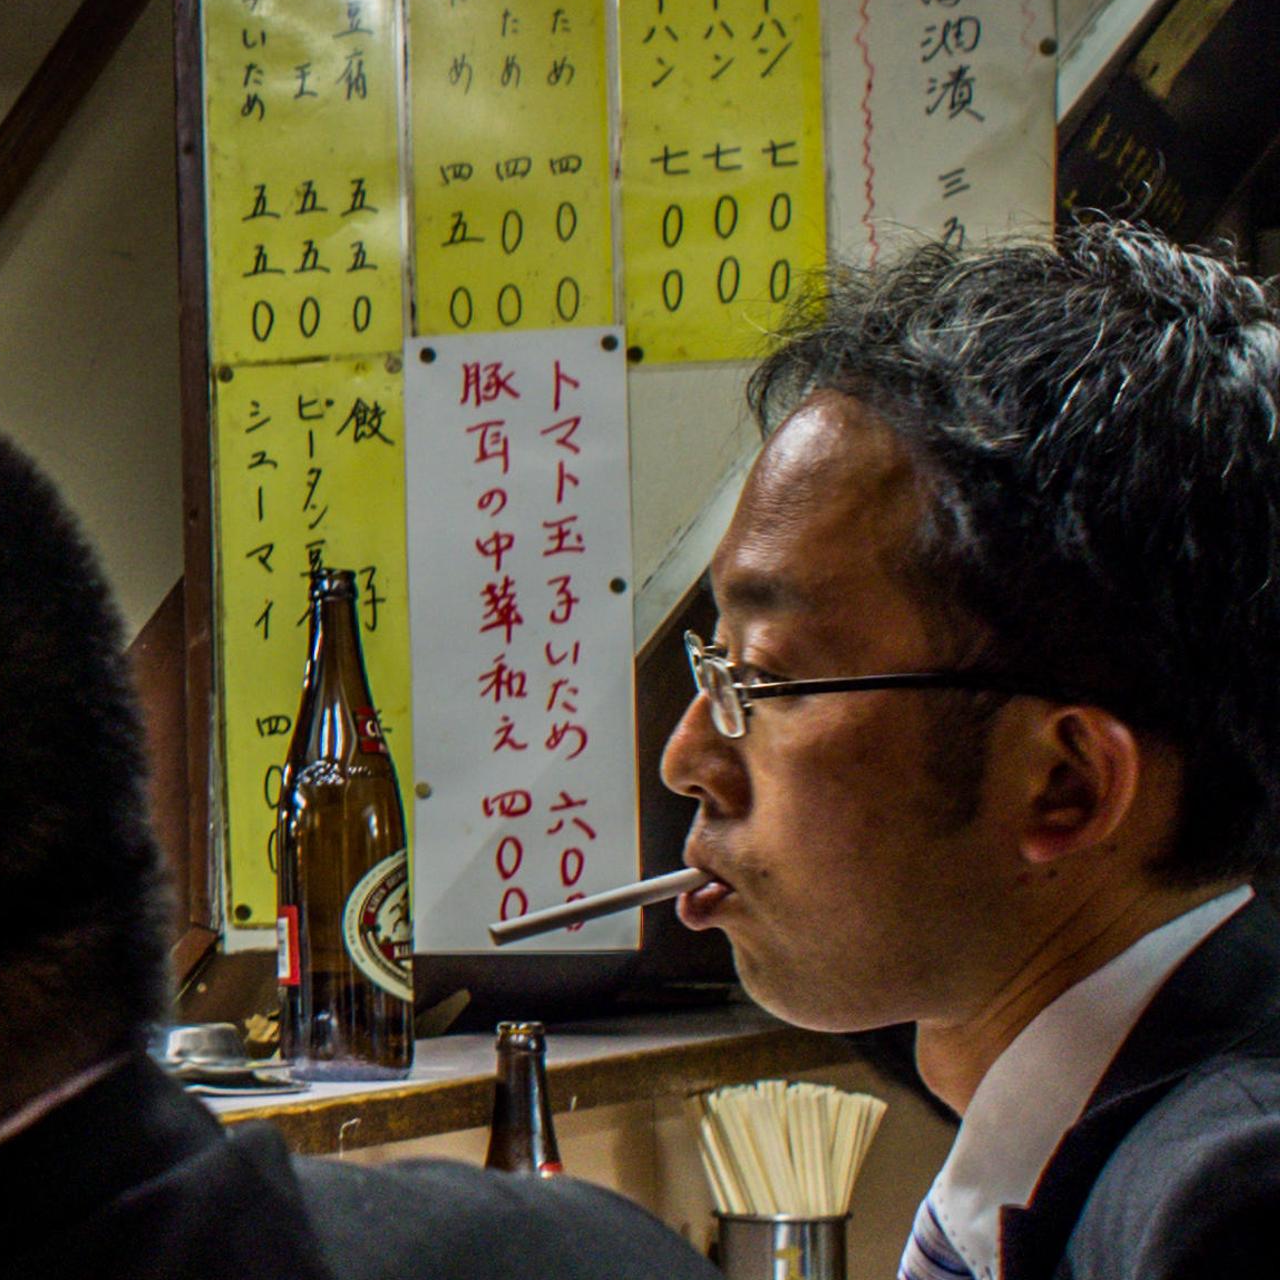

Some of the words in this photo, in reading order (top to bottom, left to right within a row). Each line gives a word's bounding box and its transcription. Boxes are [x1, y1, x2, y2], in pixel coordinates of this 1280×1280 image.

[244, 400, 278, 640] シューマイ
[335, 396, 396, 633] 餃子
[459, 361, 529, 753] 豚耳の中華和え
[539, 359, 589, 761] トマト玉子いため
